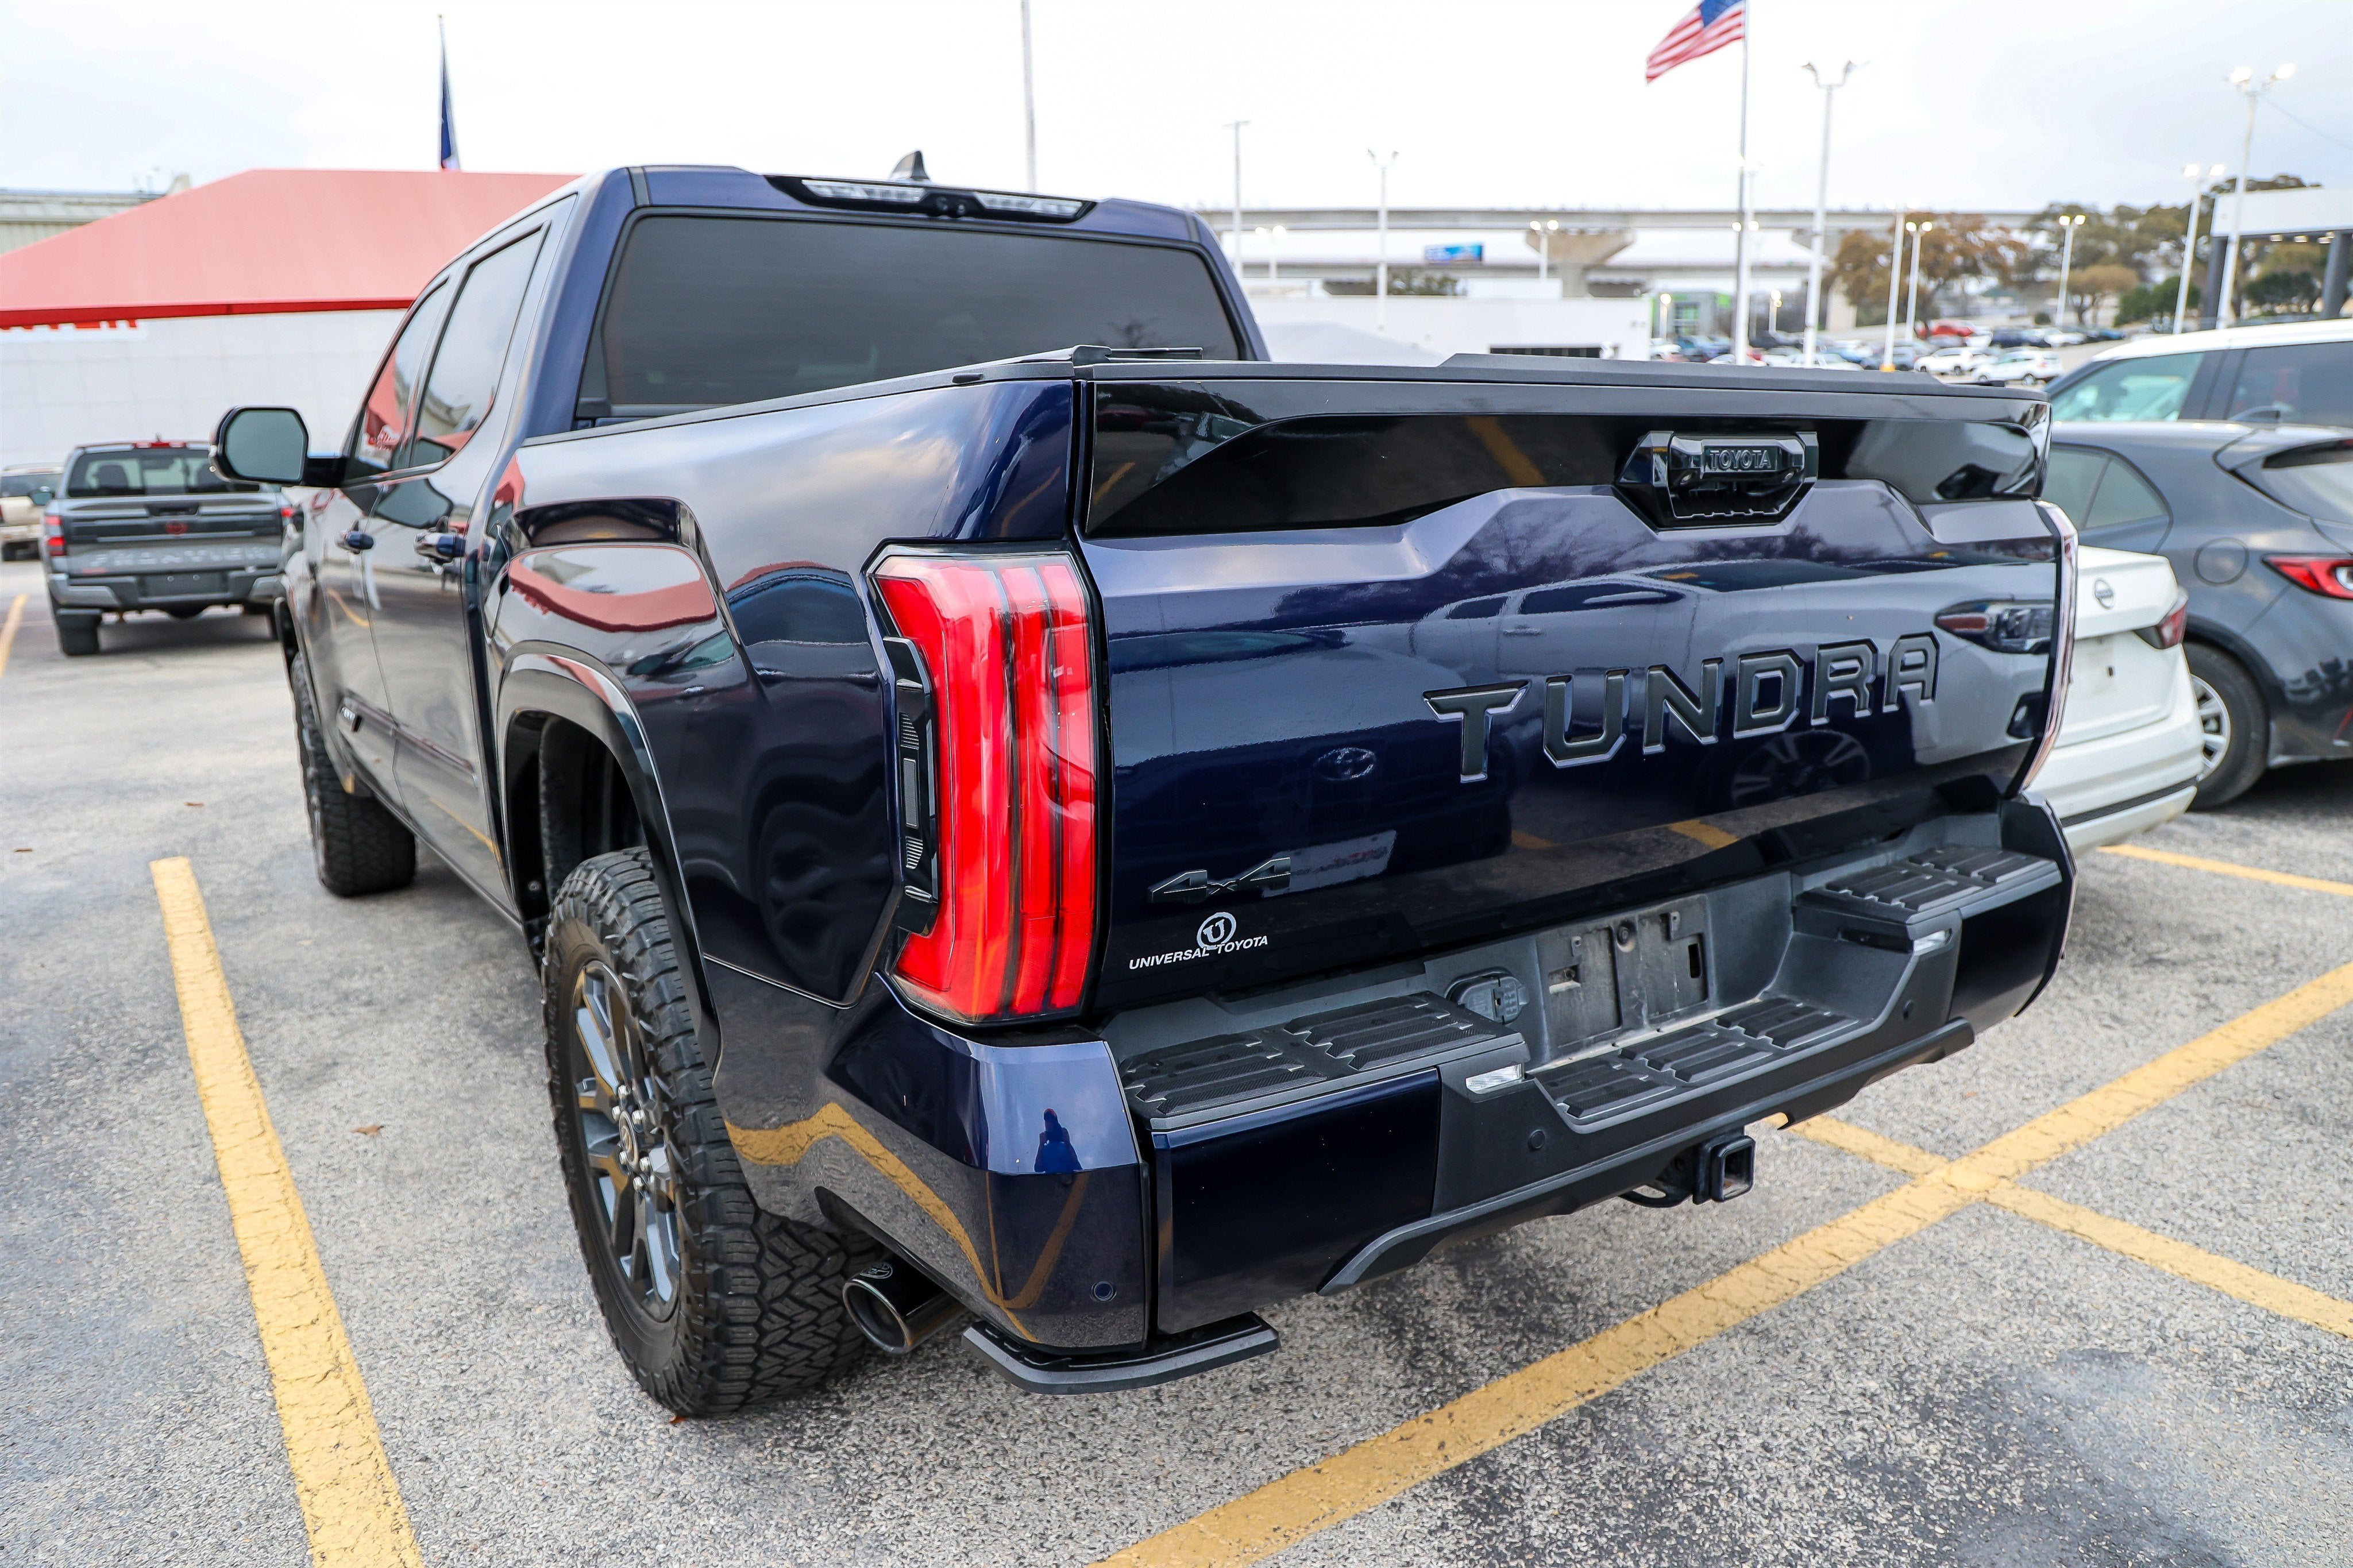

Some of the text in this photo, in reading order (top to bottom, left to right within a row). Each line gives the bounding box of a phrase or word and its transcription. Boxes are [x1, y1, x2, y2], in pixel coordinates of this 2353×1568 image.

[1710, 450, 1772, 469] TOYOTA
[1423, 631, 1941, 783] TUNDRA
[1203, 920, 1225, 943] U
[1129, 936, 1268, 970] UNIVERSAL TOYOTA
